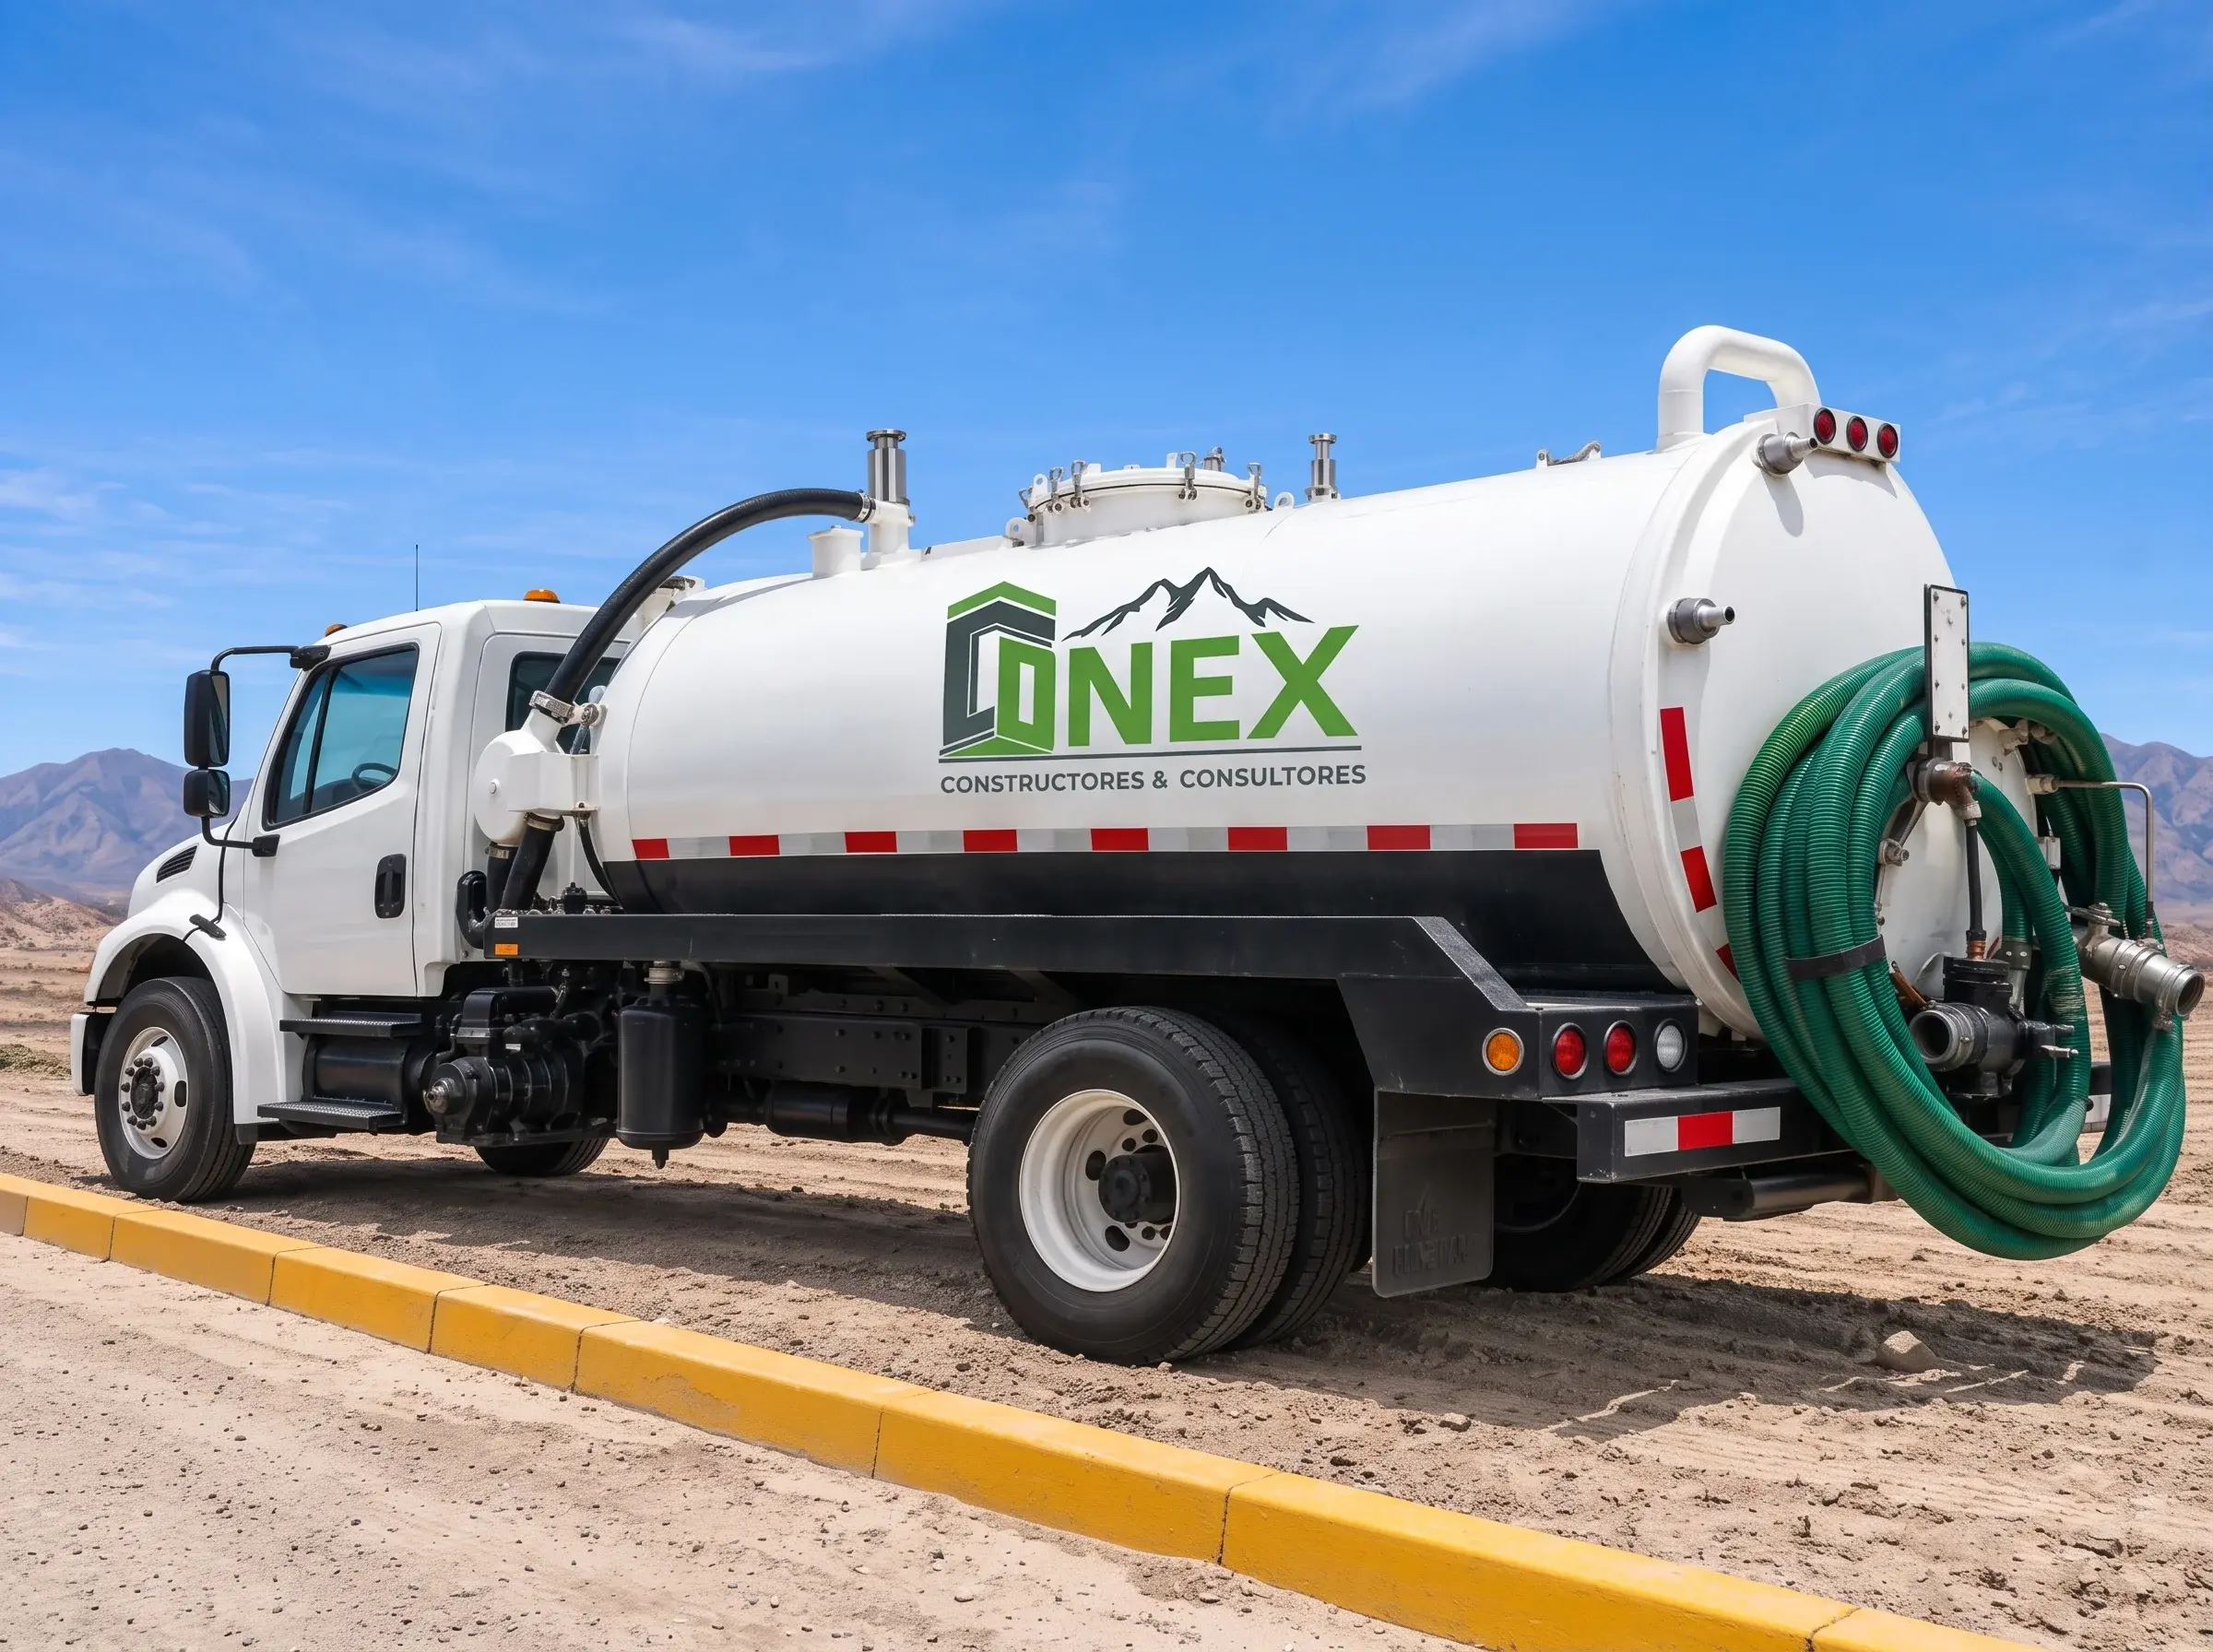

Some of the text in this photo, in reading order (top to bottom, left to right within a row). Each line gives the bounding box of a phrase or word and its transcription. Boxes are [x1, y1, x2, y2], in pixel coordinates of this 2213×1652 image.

[939, 581, 1360, 757] CONEX
[941, 764, 1367, 794] CONSTRUCTORES & CONSULTORES
